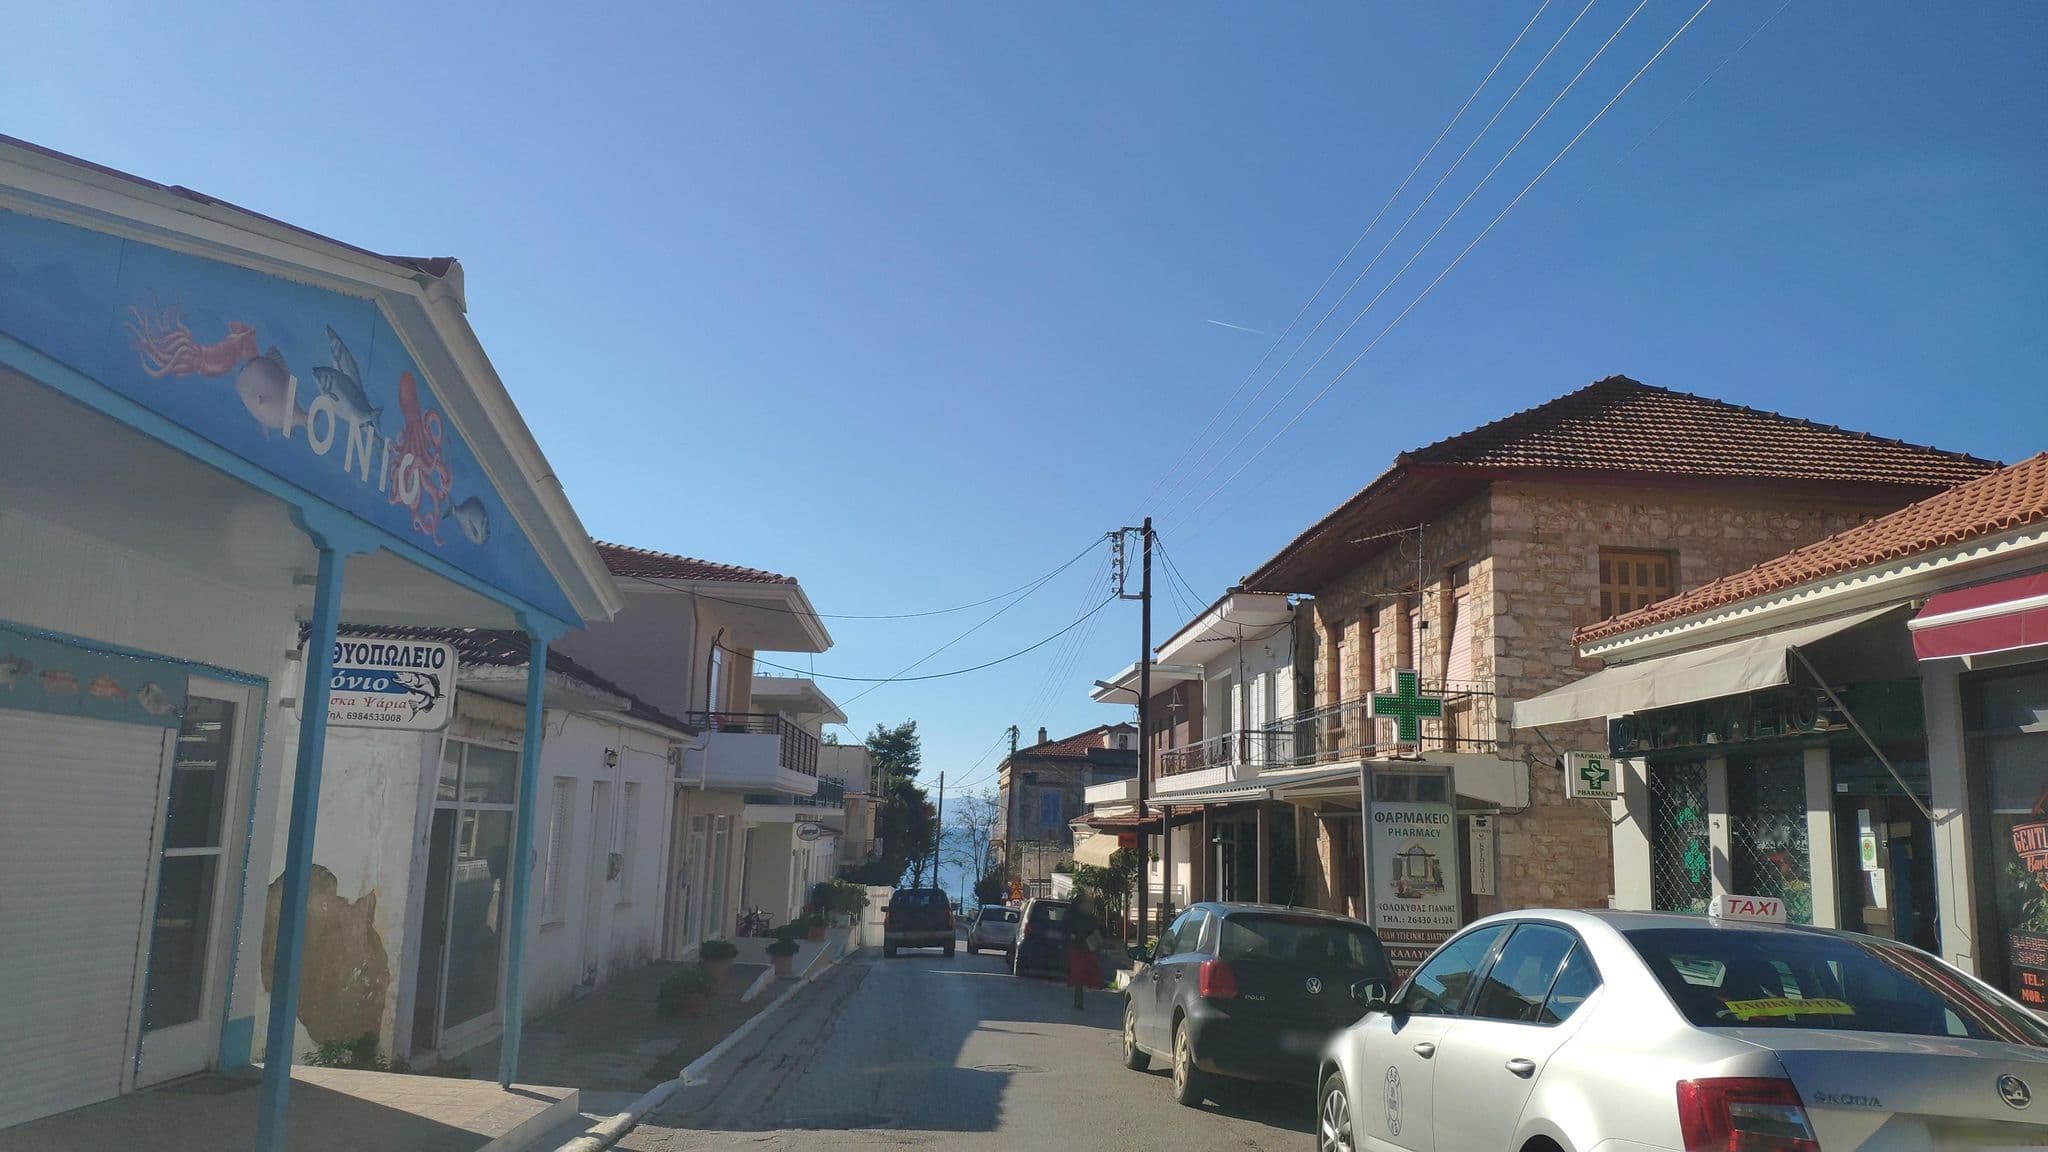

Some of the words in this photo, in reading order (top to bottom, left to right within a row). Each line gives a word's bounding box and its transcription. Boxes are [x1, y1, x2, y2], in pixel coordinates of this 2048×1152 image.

[333, 641, 446, 669] ΘΥΟΠΩΛΕΙΟ
[330, 670, 390, 690] όνιο
[330, 696, 356, 706] σκα
[1577, 789, 1615, 797] PHARMACY
[1374, 811, 1450, 824] ΦΑΡΜΑΚΕΙΟ
[1387, 828, 1441, 838] PHARMACY
[1728, 899, 1778, 916] TAXI
